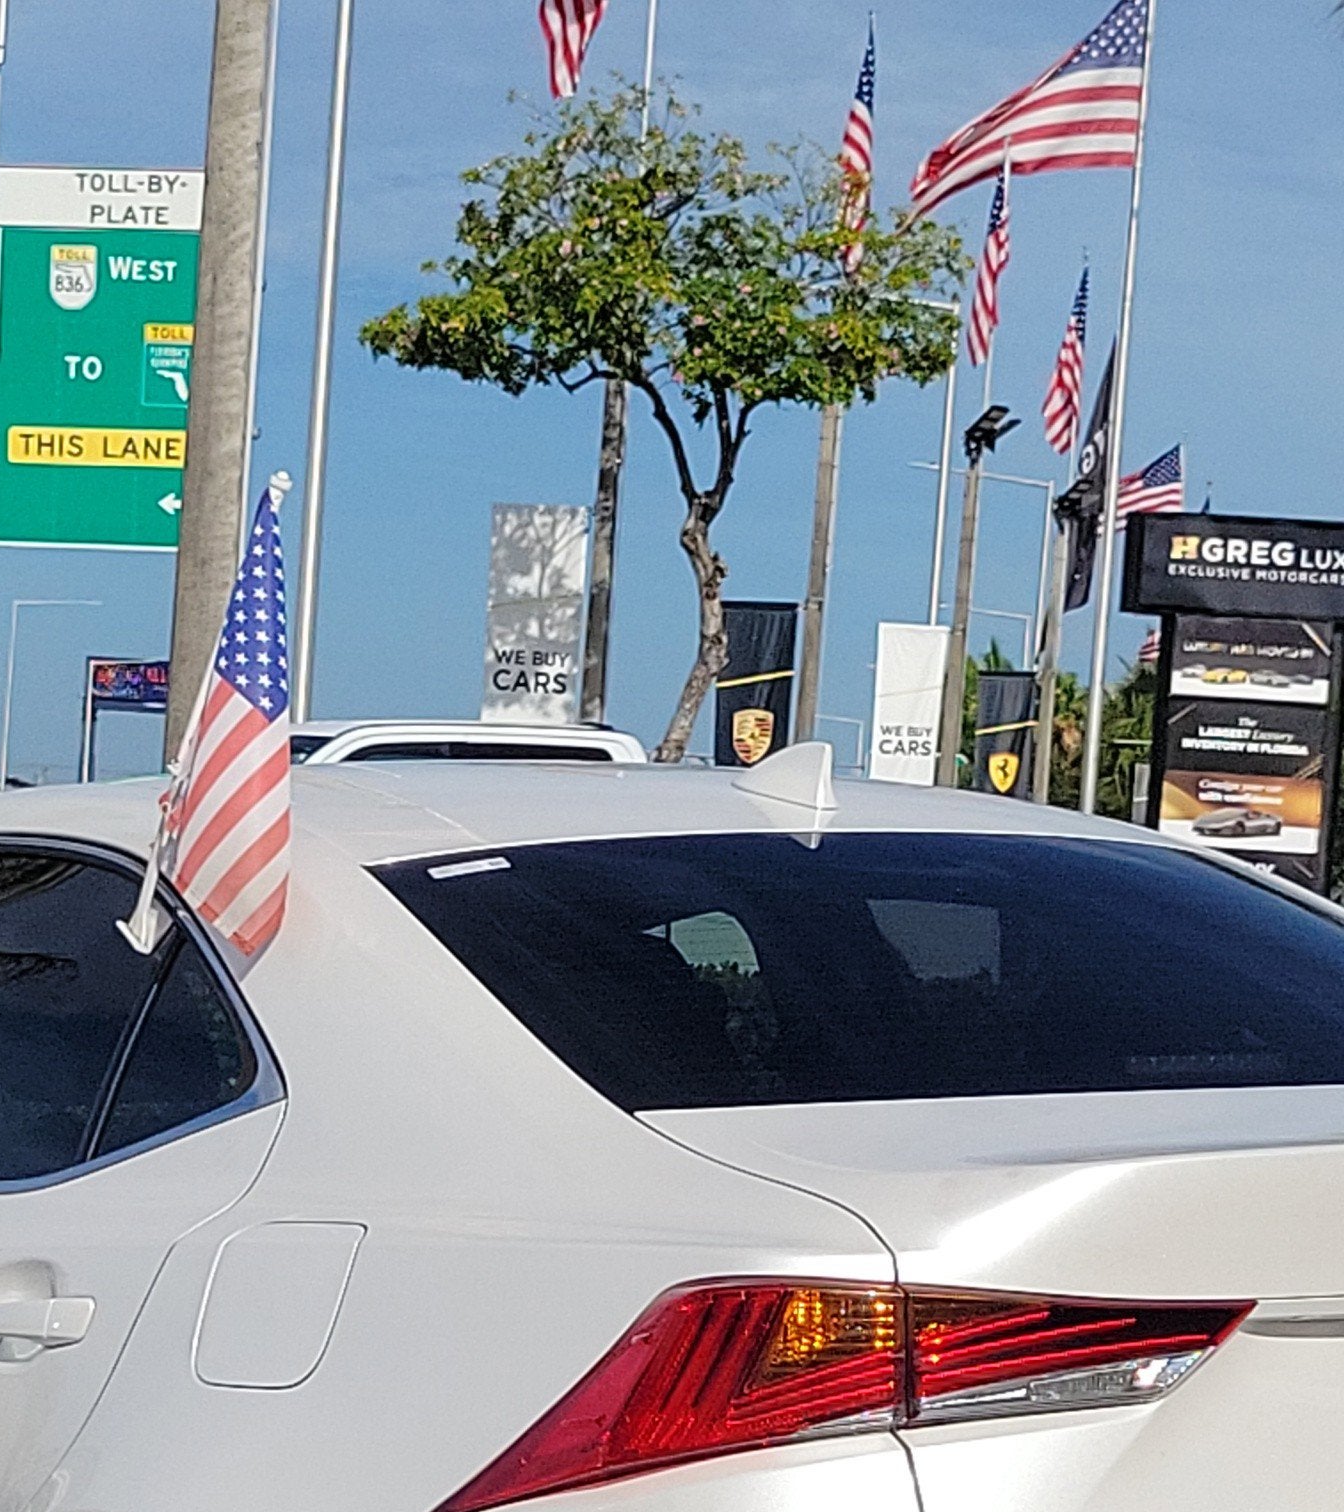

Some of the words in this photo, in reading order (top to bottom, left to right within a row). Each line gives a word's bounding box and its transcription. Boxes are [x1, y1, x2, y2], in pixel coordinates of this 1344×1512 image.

[76, 173, 188, 194] TOLL-BY-
[90, 205, 169, 225] PLATE
[59, 248, 91, 261] TOLL
[108, 256, 178, 282] WEST
[55, 274, 84, 293] 836
[152, 326, 189, 341] TOLL
[64, 355, 103, 381] TO
[19, 433, 84, 458] THIS
[103, 436, 182, 461] LANE
[1167, 563, 1252, 582] EXCLUSIVE
[494, 648, 526, 666] WE
[532, 650, 570, 668] BUY
[492, 668, 568, 695] CARS
[879, 725, 904, 737] WE
[878, 739, 932, 757] CARS
